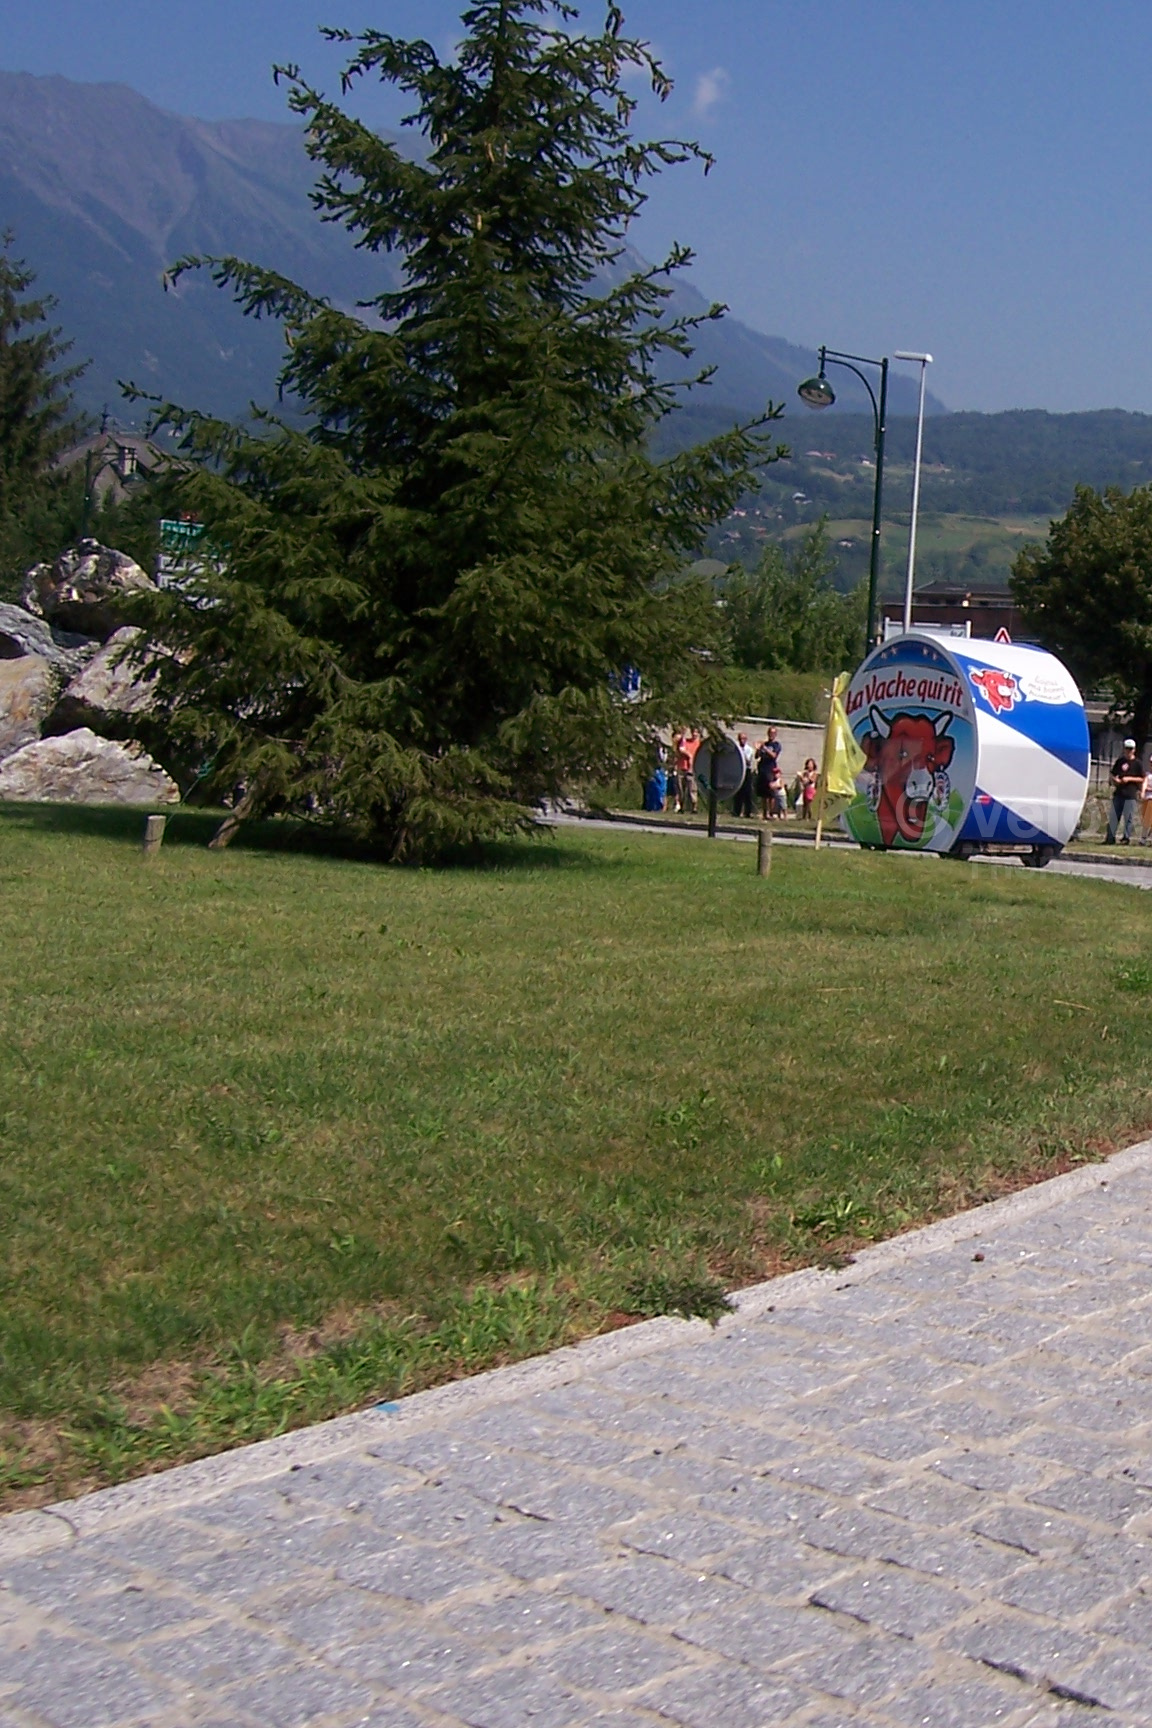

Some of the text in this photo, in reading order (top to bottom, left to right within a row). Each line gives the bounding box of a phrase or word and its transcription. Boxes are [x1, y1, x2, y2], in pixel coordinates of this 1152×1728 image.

[846, 671, 963, 715] La Vache qui rit
